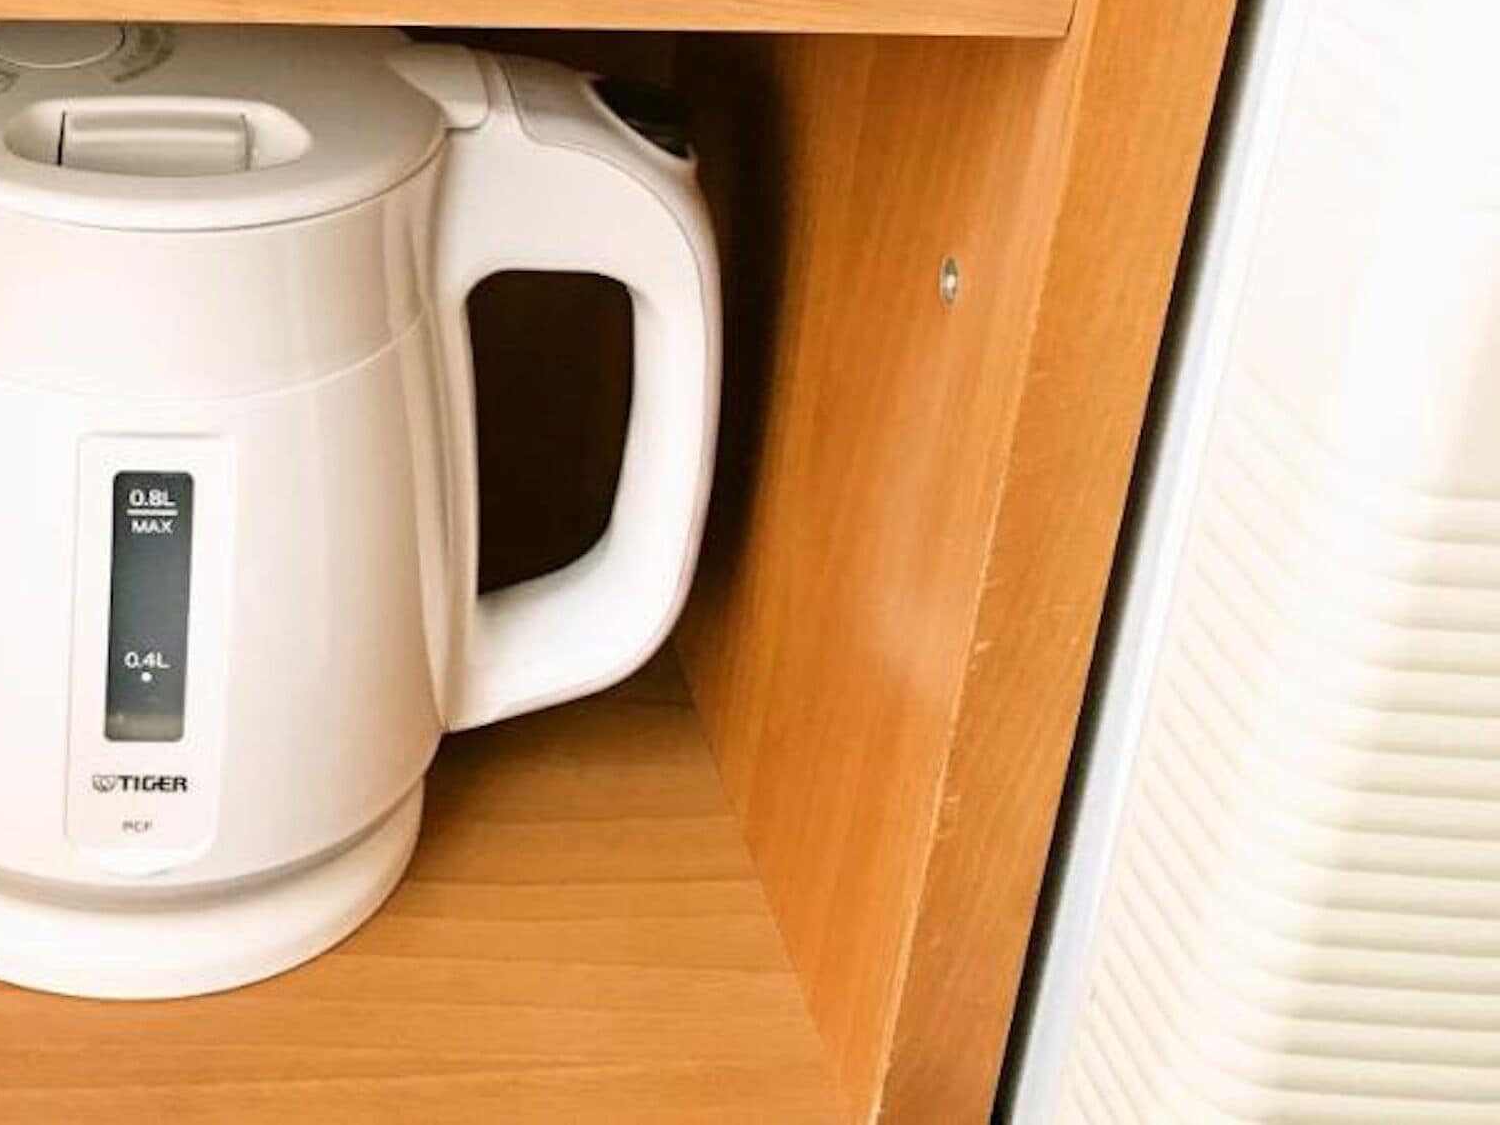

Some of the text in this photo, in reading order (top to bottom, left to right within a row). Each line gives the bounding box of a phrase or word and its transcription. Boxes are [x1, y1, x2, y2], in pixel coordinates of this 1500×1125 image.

[128, 488, 176, 509] 0.8L
[130, 519, 174, 534] MAX
[124, 650, 170, 669] 0.4L
[117, 773, 188, 793] TIGER
